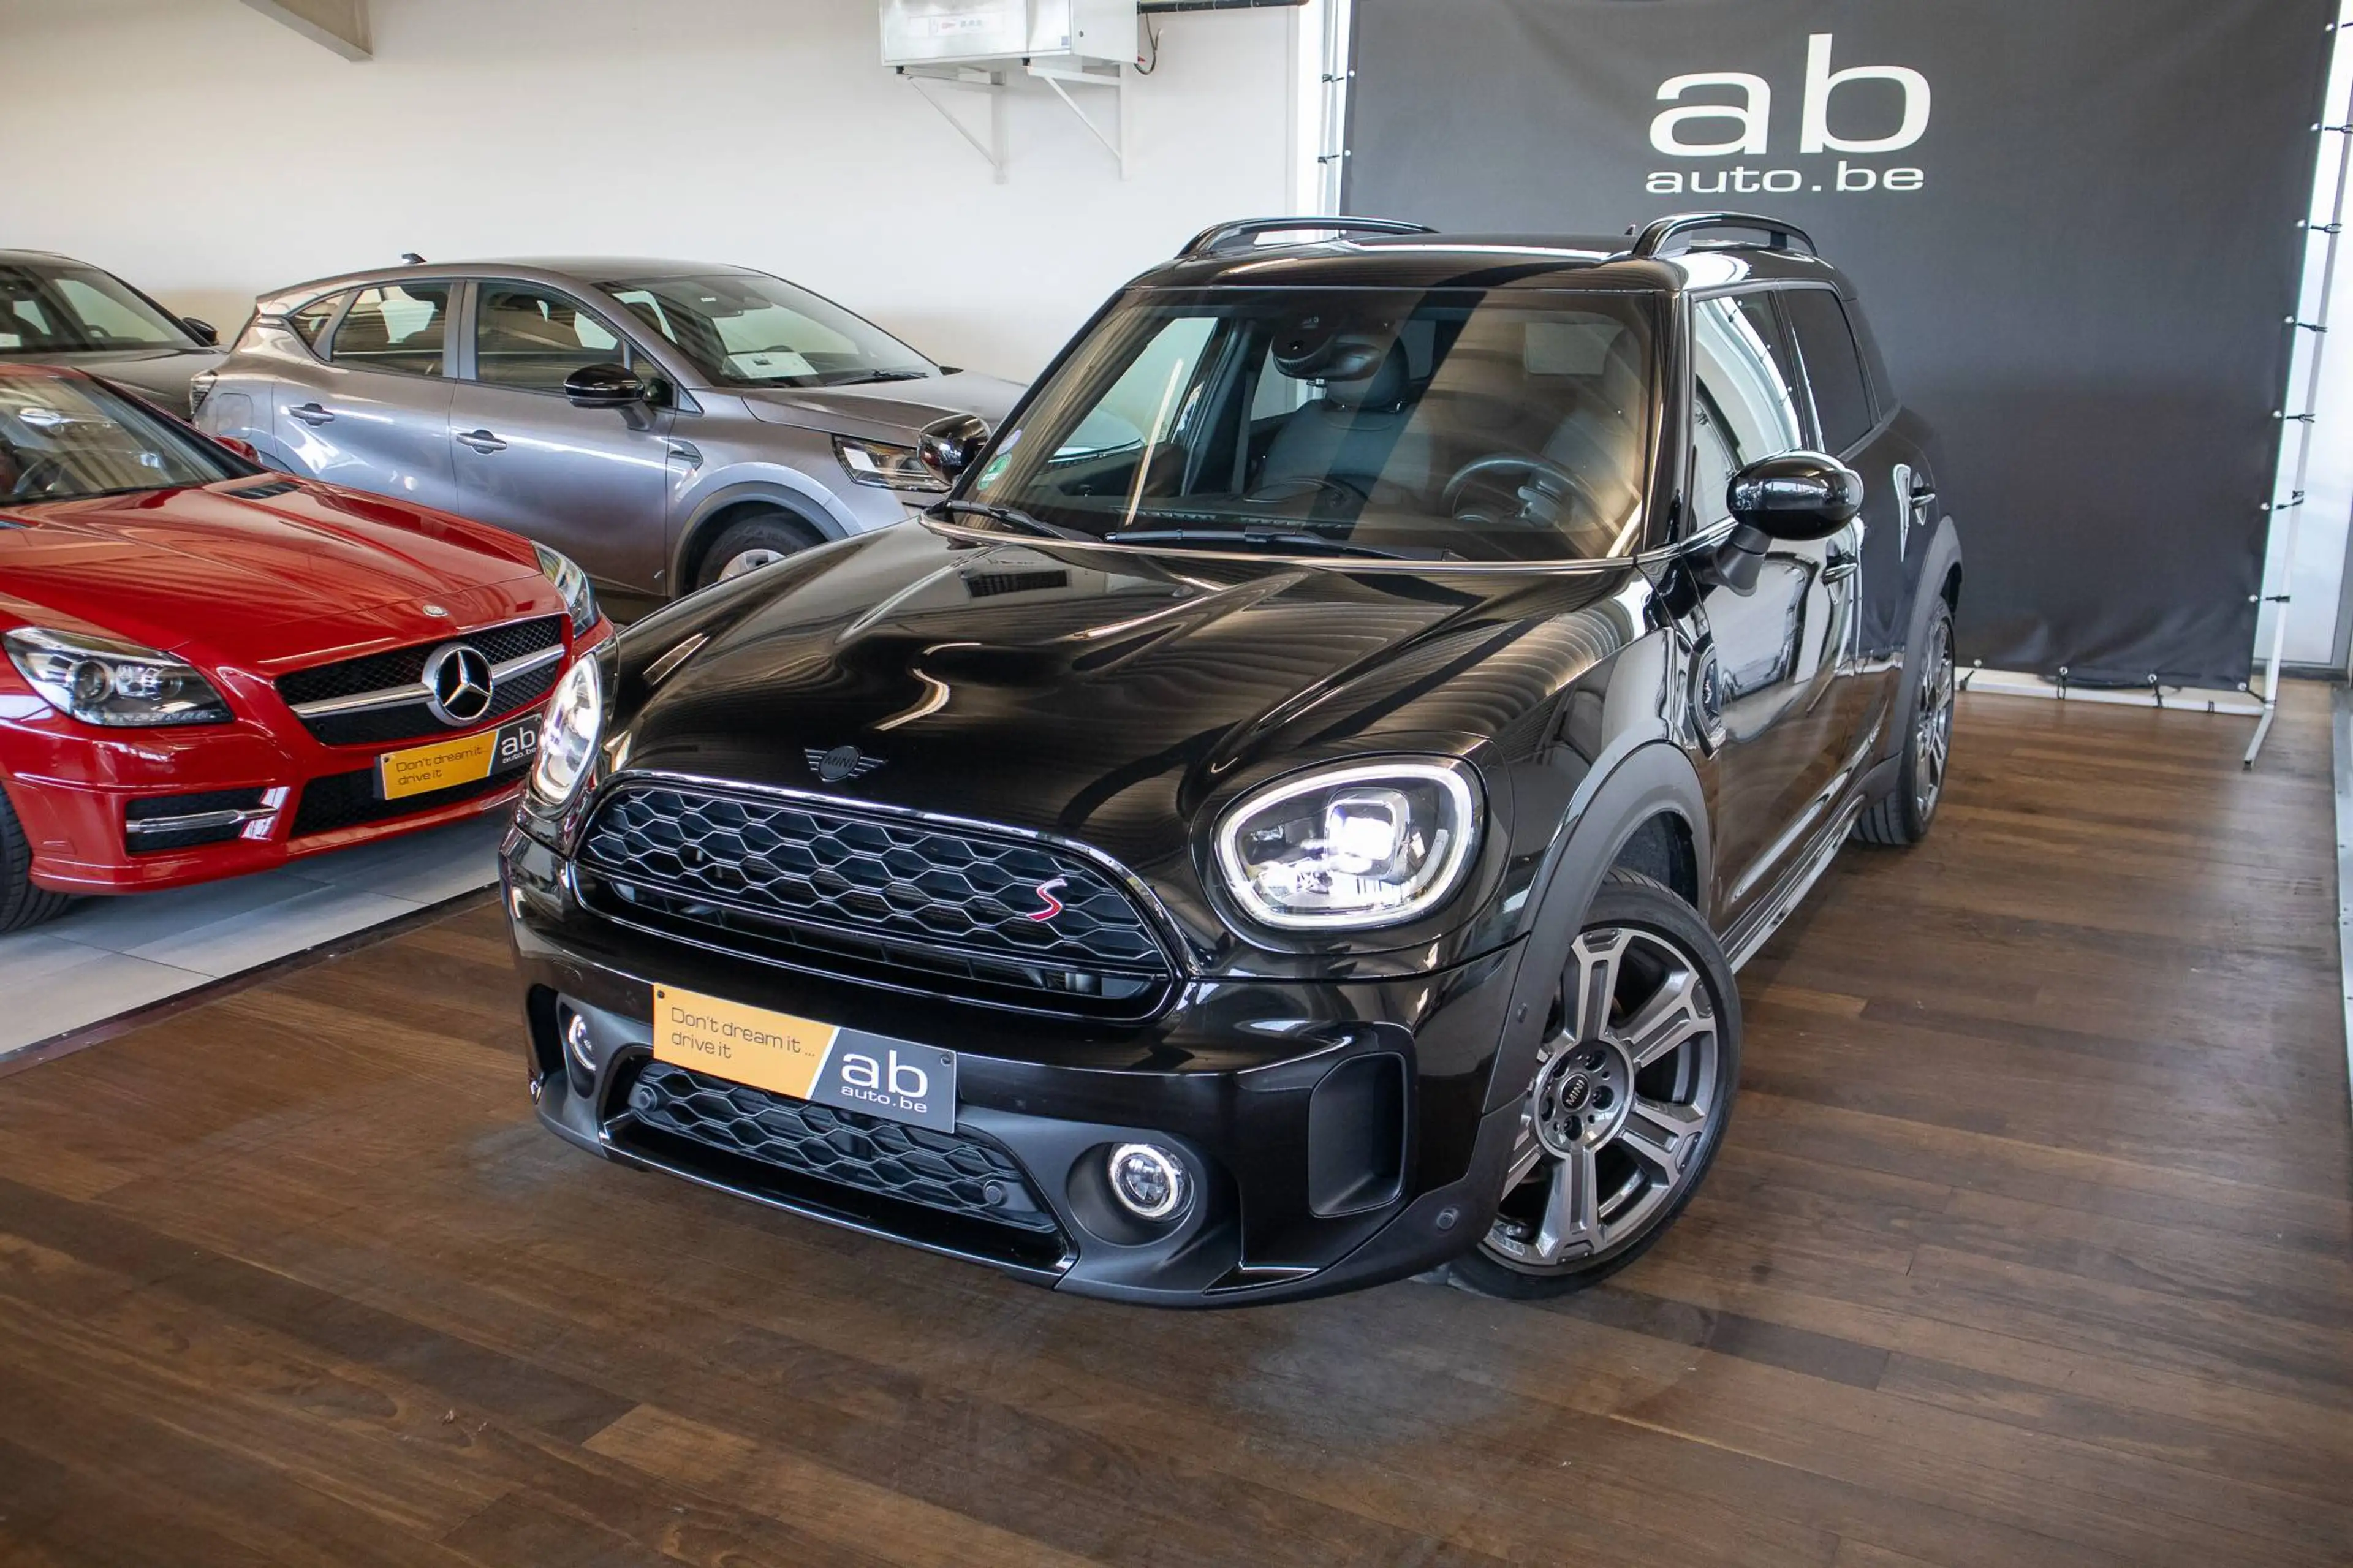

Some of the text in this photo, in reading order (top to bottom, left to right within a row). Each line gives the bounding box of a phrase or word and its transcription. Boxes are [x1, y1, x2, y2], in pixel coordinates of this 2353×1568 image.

[1650, 33, 1931, 156] ab
[1645, 161, 1924, 194] auto.be
[502, 727, 536, 756] ab
[396, 758, 431, 773] Don't
[434, 750, 472, 765] dream
[398, 772, 431, 785] drive
[1026, 878, 1068, 922] S
[672, 1007, 719, 1032] Don't
[722, 1022, 784, 1049] dream
[672, 1032, 732, 1059] drive it
[841, 1050, 928, 1098] ab
[841, 1086, 928, 1113] auto.be
[1566, 1079, 1585, 1106] MINI
